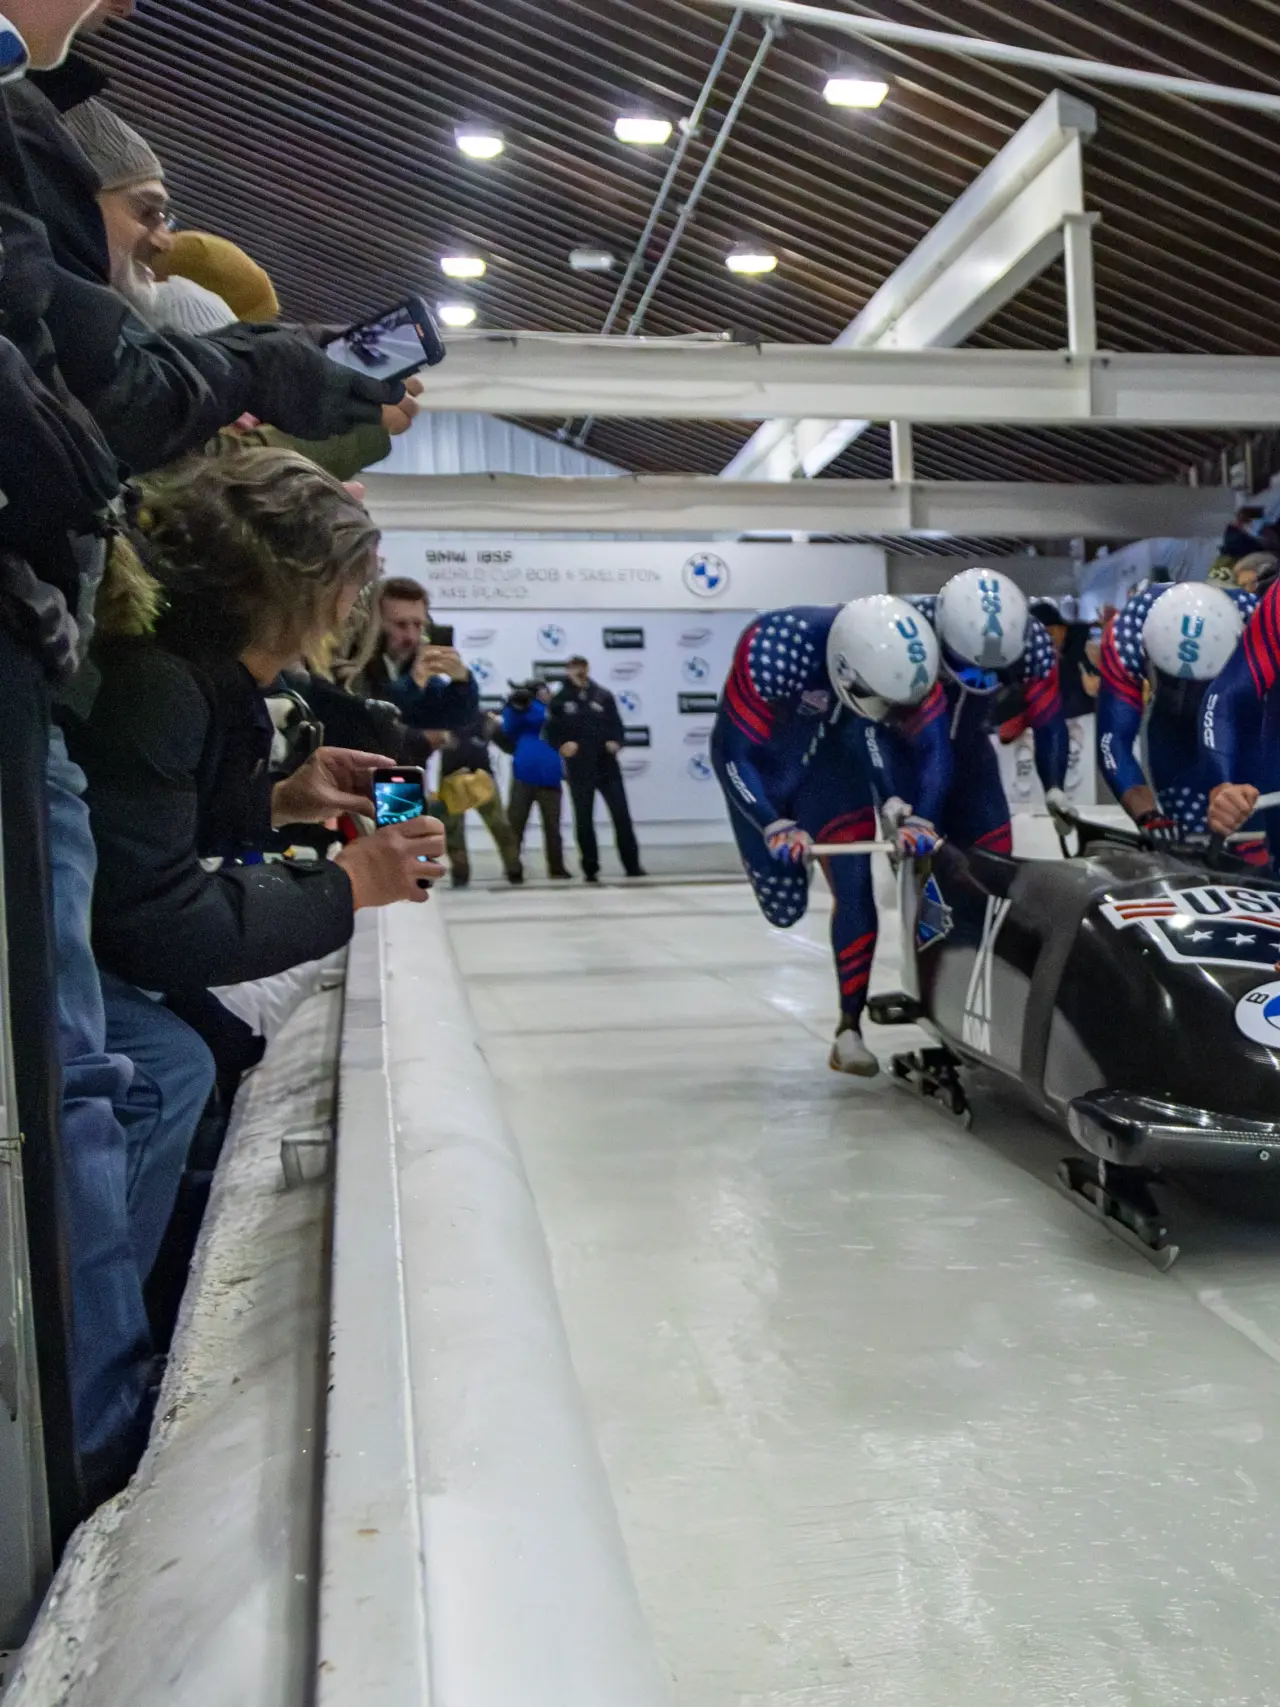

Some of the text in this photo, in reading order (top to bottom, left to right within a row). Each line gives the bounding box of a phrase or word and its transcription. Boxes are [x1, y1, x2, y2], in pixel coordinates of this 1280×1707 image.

[578, 568, 661, 581] SKELETON
[1203, 693, 1218, 749] USA
[726, 760, 757, 803] USA
